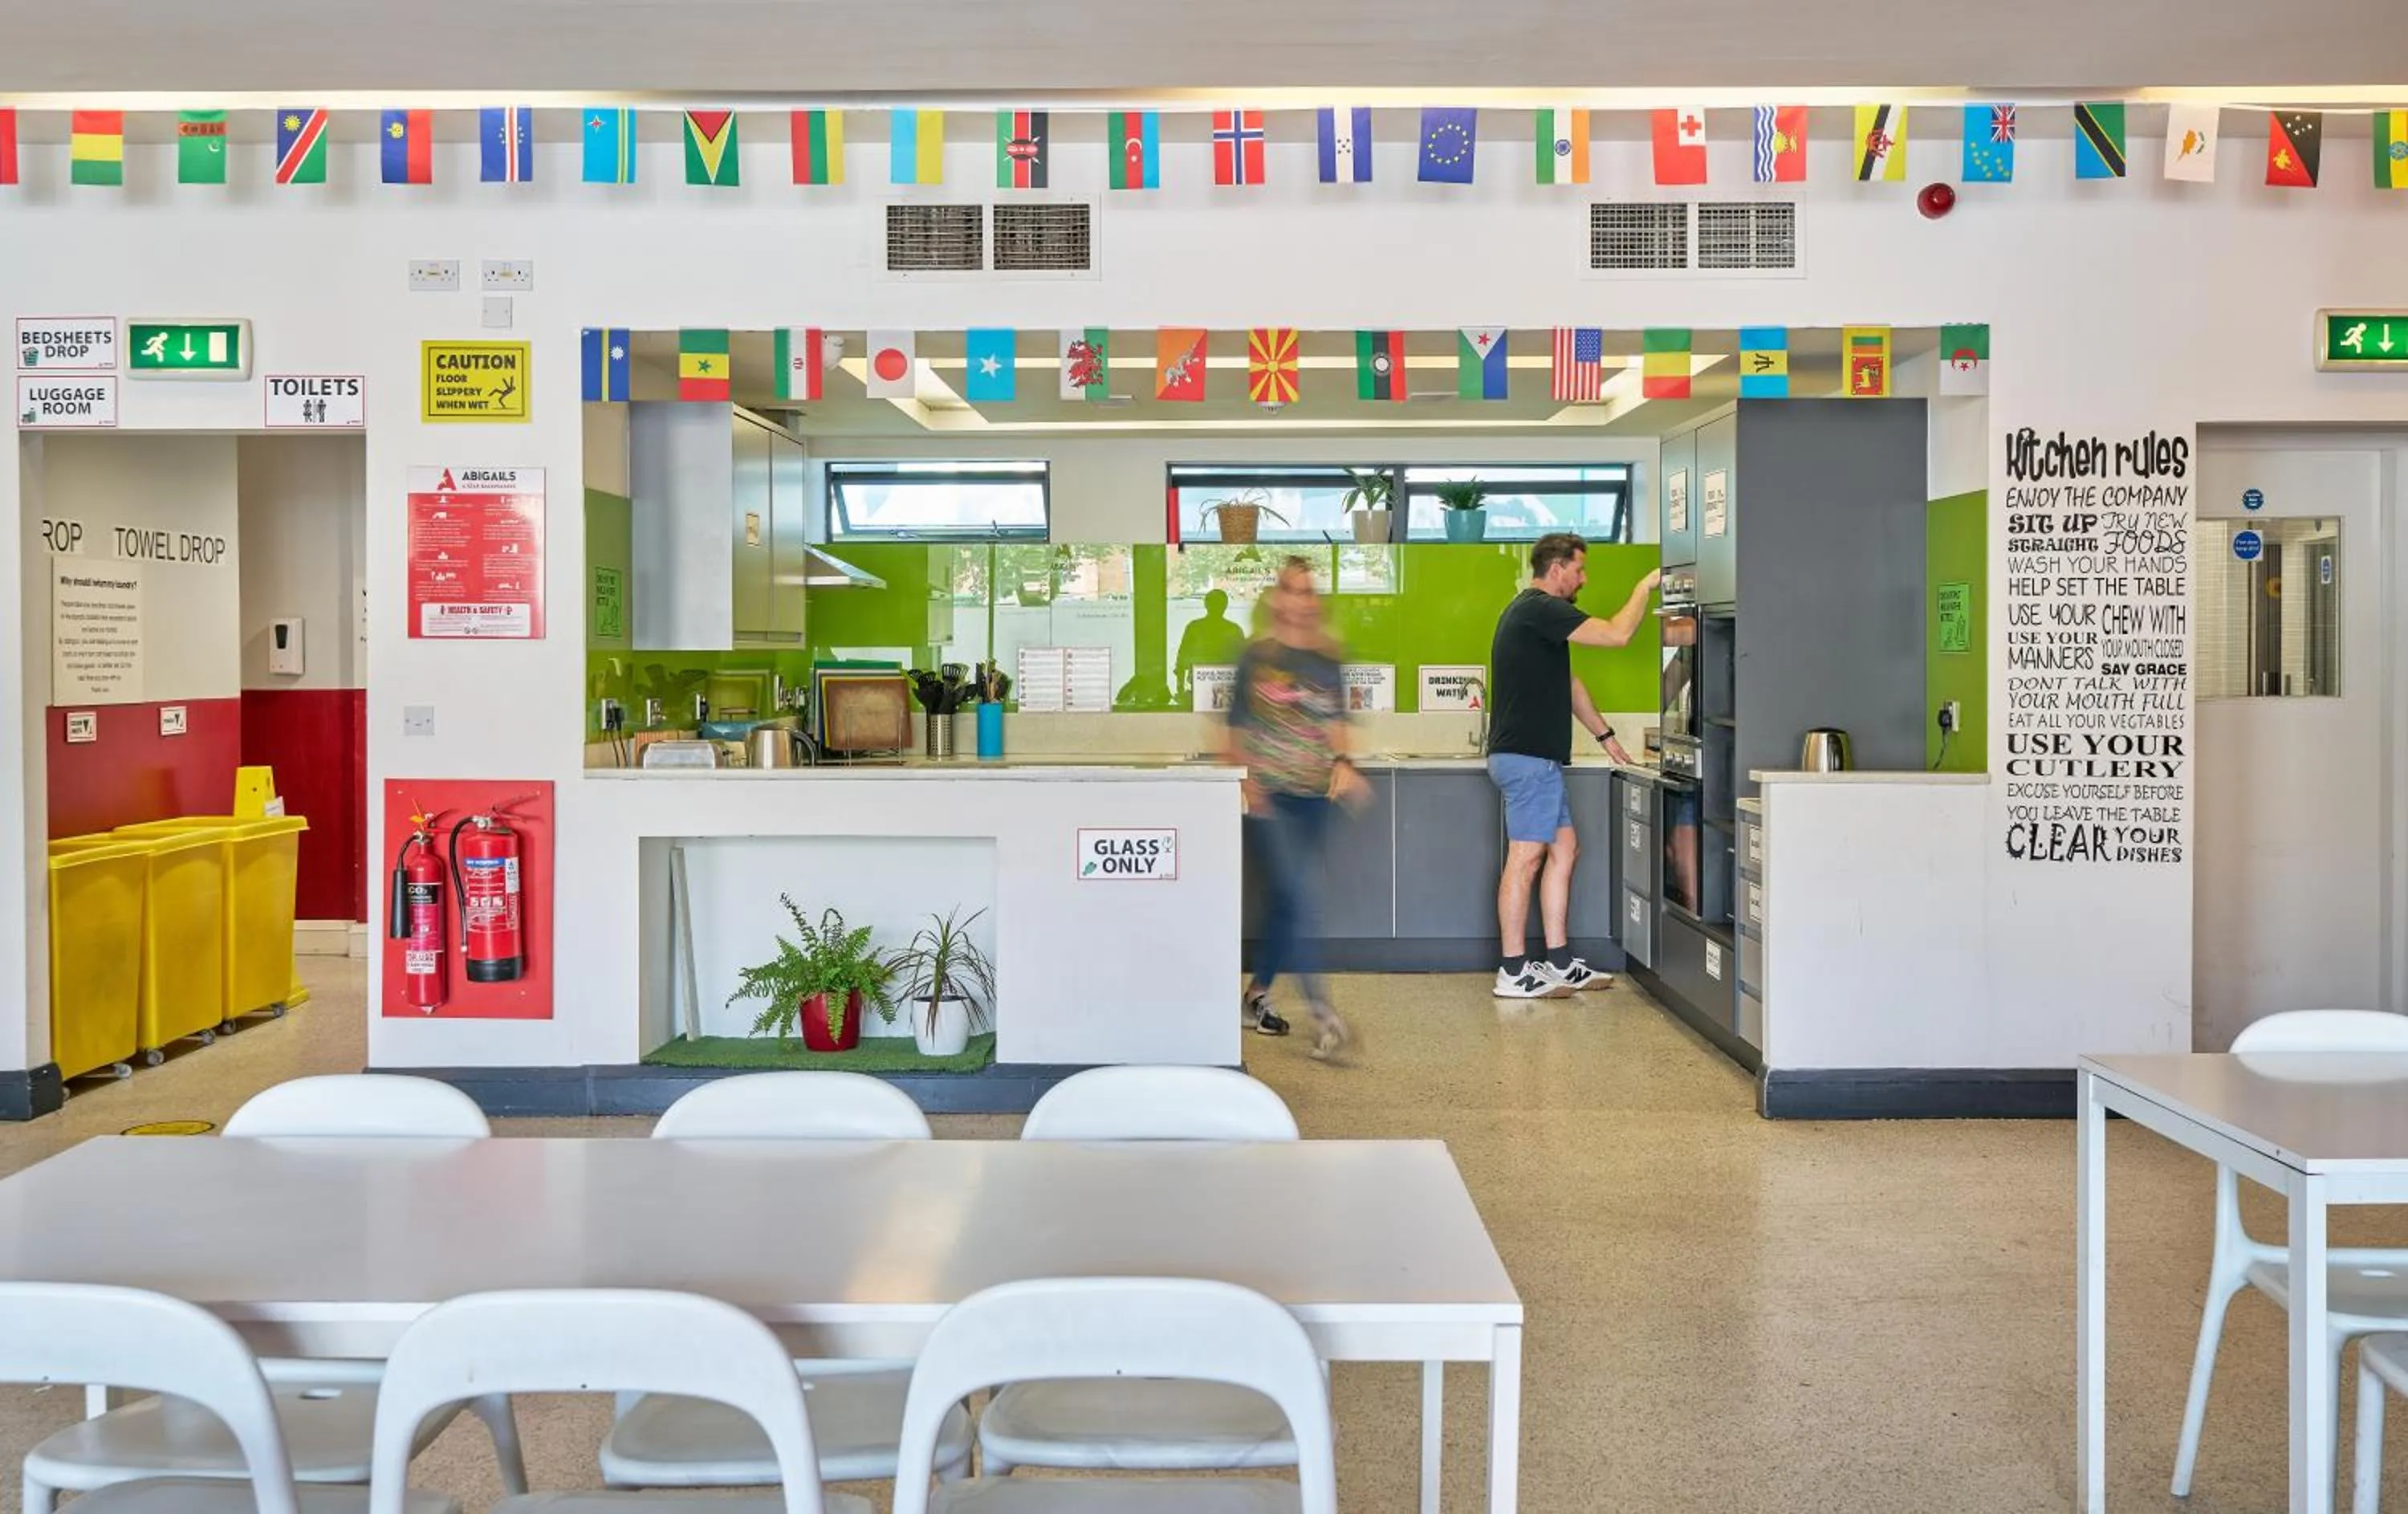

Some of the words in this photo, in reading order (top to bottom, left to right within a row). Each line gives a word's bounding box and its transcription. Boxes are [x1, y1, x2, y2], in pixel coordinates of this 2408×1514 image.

[22, 331, 112, 344] BEDSHEETS
[45, 344, 89, 358] DROP
[436, 354, 516, 369] CAUTION
[270, 378, 359, 396] TOILETS
[436, 374, 467, 383] FLOOR
[29, 388, 105, 401] LUGGAGE
[436, 388, 482, 396] SLIPPERY
[43, 402, 91, 414] ROOM
[436, 401, 466, 409] WHEN
[469, 401, 489, 409] WET
[2115, 430, 2189, 478] rules
[2006, 486, 2060, 508] ENJOY
[2064, 486, 2097, 507] THE
[2102, 485, 2188, 507] COMPANY
[2007, 514, 2054, 533] SIT
[2062, 514, 2098, 533] UP
[2101, 511, 2139, 531] TRY
[2145, 511, 2187, 530] NEW
[115, 527, 176, 560] TOWEL
[181, 534, 226, 564] DROP
[2007, 537, 2099, 553] STRAIGHT
[2103, 530, 2187, 555] FOODS
[2007, 556, 2060, 574] WASH
[2068, 556, 2119, 573] YOUR
[2125, 556, 2187, 574] HANDS
[2009, 577, 2051, 596] HELP
[2056, 577, 2087, 596] SET
[2093, 577, 2128, 596] THE
[2133, 577, 2186, 596] TABLE
[2007, 603, 2042, 626] USE
[2049, 603, 2097, 626] YOUR
[2102, 604, 2145, 635] CHEW
[2150, 604, 2186, 635] WITH
[2007, 632, 2041, 645] USE
[2047, 632, 2098, 645] YOUR
[2101, 639, 2123, 658] YOUR
[2124, 639, 2154, 658] MOUTH
[2154, 638, 2185, 659] CLOSED
[2007, 646, 2094, 669] MANNERS
[2101, 663, 2129, 675] SAY
[2134, 663, 2187, 675] GRACE
[1428, 677, 1479, 685] DRINKI
[2007, 677, 2068, 691] DONT
[2073, 677, 2123, 690] TALK
[2133, 677, 2187, 691] WITH
[1436, 688, 1468, 697] WATR
[2008, 692, 2060, 710] YOUR
[2065, 692, 2135, 710] MOUTH
[2142, 692, 2187, 711] FULL
[2009, 713, 2034, 728] EAT
[2037, 714, 2062, 728] ALL
[2065, 714, 2106, 729] YOUR
[2007, 733, 2072, 755] USE
[2081, 734, 2185, 756] YOUR
[2006, 759, 2185, 779] CUTLERY
[2007, 783, 2060, 799] EXCUSE
[2062, 784, 2129, 800] YOURSELF
[2133, 785, 2184, 800] BEFORE
[2006, 805, 2038, 821] YOU
[2042, 806, 2093, 821] LEAVE
[2097, 807, 2128, 821] THE
[2131, 808, 2182, 823] TABLE
[2006, 822, 2112, 862] CLEAR
[2113, 827, 2182, 845] YOUR
[1094, 839, 1160, 855] GLASS
[2116, 846, 2182, 862] DISHES
[1102, 857, 1157, 873] ONLY
